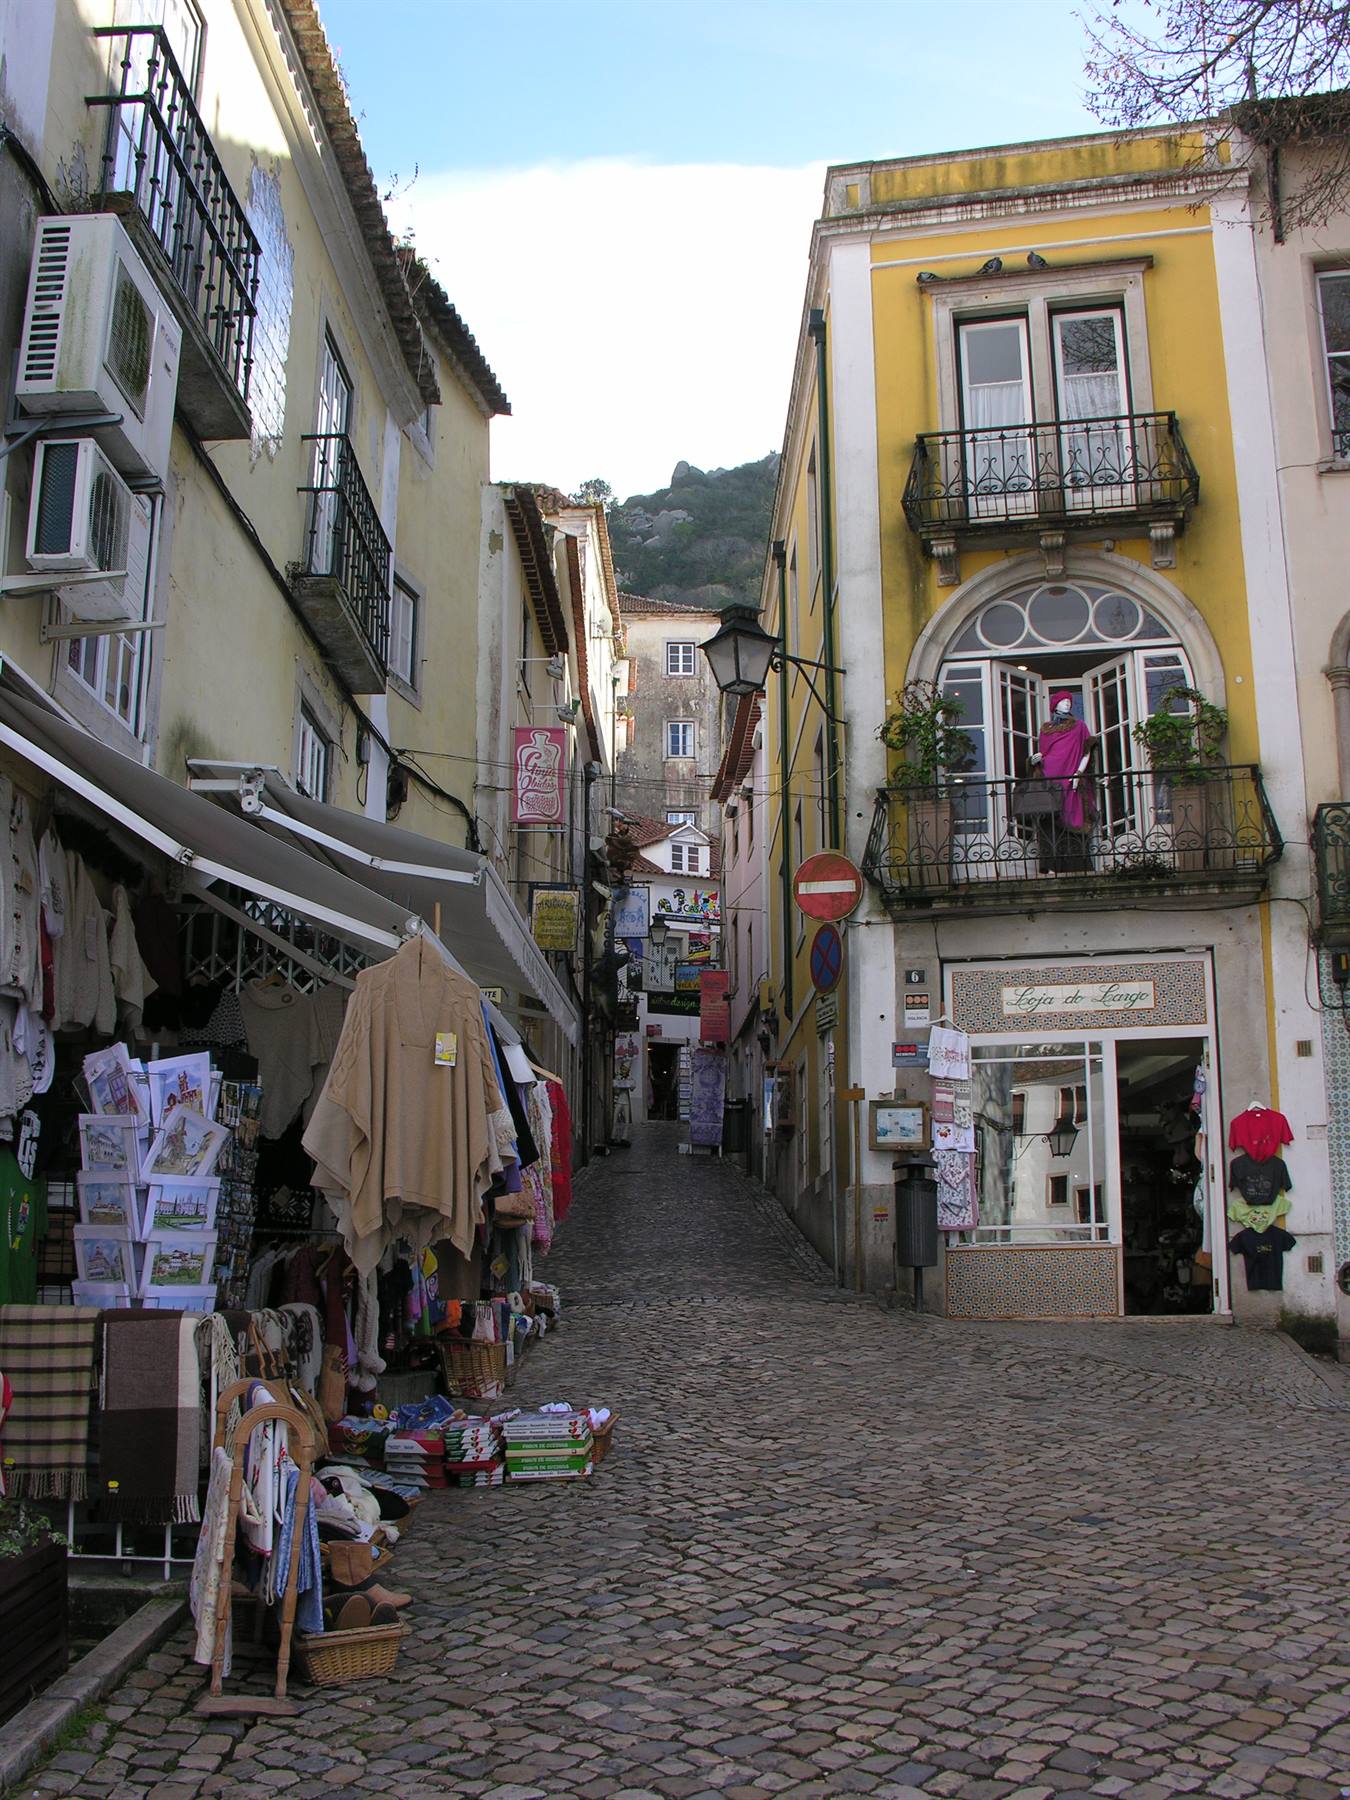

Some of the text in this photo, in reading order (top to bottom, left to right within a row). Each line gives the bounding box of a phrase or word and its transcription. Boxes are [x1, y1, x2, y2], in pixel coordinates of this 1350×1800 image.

[911, 970, 919, 984] 6
[1006, 983, 1149, 1013] Loja do Largo
